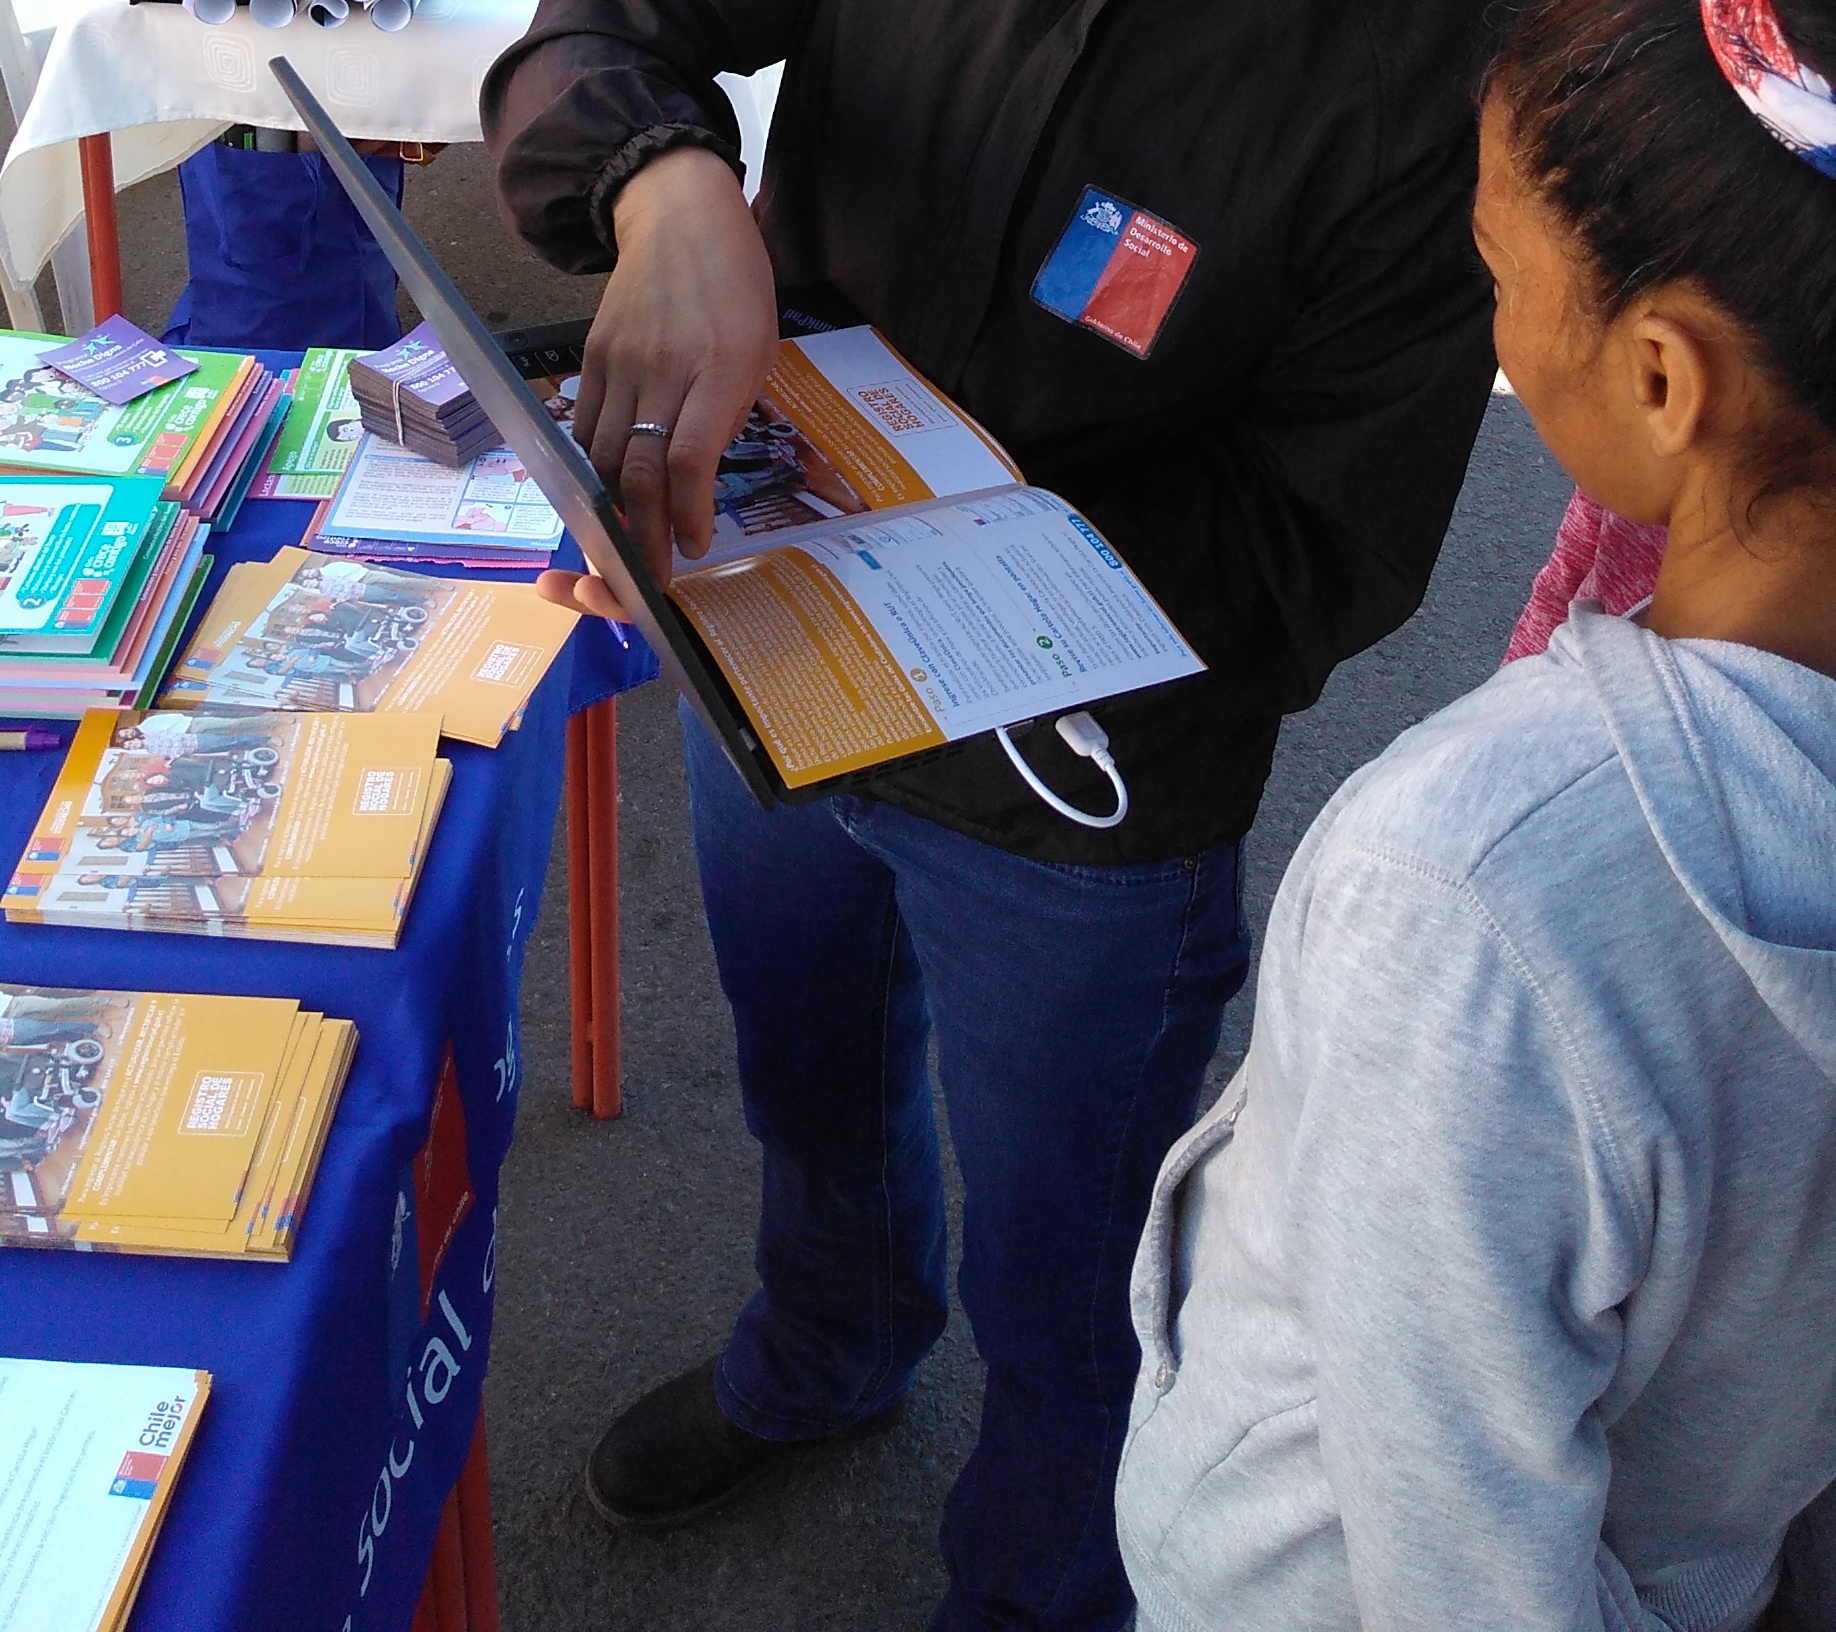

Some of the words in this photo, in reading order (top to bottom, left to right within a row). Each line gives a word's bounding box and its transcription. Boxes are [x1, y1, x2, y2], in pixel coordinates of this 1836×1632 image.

[1124, 238, 1150, 258] Social
[1130, 227, 1172, 256] Desarrollo
[1135, 216, 1177, 246] Ministerio
[1178, 241, 1189, 254] de
[91, 343, 124, 360] Digna
[1114, 330, 1124, 340] de
[1124, 335, 1142, 350] Chile
[406, 348, 437, 365] Digna
[89, 376, 112, 387] 800
[107, 369, 131, 380] 104
[126, 360, 150, 372] 777
[408, 379, 429, 389] 800
[424, 371, 446, 382] 104
[866, 389, 884, 400] DE
[876, 387, 925, 427] HOGARES
[172, 404, 193, 424] crece
[183, 398, 210, 426] contigo
[855, 390, 905, 431] REGISTRO
[879, 401, 915, 429] SOCIAL
[114, 434, 132, 445] 3
[260, 474, 276, 497] Lactan
[1070, 517, 1089, 532] 777
[102, 535, 130, 568] contigo
[1084, 533, 1103, 548] 104
[91, 543, 111, 568] crece
[994, 554, 1020, 582] pantalla
[1098, 549, 1118, 566] 800
[1014, 581, 1028, 591] en
[22, 594, 41, 609] 2
[882, 600, 898, 615] RUT
[1021, 591, 1044, 612] Hogar
[1037, 612, 1063, 638] Cartola
[715, 638, 724, 646] al
[896, 621, 931, 663] ClaveÚnica
[1057, 638, 1070, 648] su
[476, 644, 505, 677] REGISTRO
[485, 655, 505, 678] SOCIAL
[500, 645, 512, 654] DE
[492, 646, 520, 680] HOGARES
[719, 645, 748, 685] pertenecer
[925, 663, 942, 678] con
[1048, 652, 1073, 677] Paso
[1064, 648, 1088, 672] Revise
[921, 686, 946, 712] Paso
[935, 678, 962, 707] Ingrese
[742, 684, 773, 728] importante
[766, 727, 779, 739] es
[772, 738, 789, 754] qué
[375, 771, 386, 781] DE
[358, 770, 377, 810] REGISTRO
[368, 782, 383, 810] SOCIAL
[377, 771, 395, 810] HOGARES
[186, 1075, 213, 1128] REGISTRO
[196, 1092, 218, 1128] SOCIAL
[209, 1076, 223, 1090] DE
[207, 1077, 234, 1129] HOGARES
[52, 1417, 66, 1430] Call
[138, 1400, 170, 1446] Chile
[154, 1394, 186, 1448] mejor
[358, 1288, 472, 1599] social
[7, 1448, 30, 1476] Cartola
[51, 1473, 77, 1510] Preguntas
